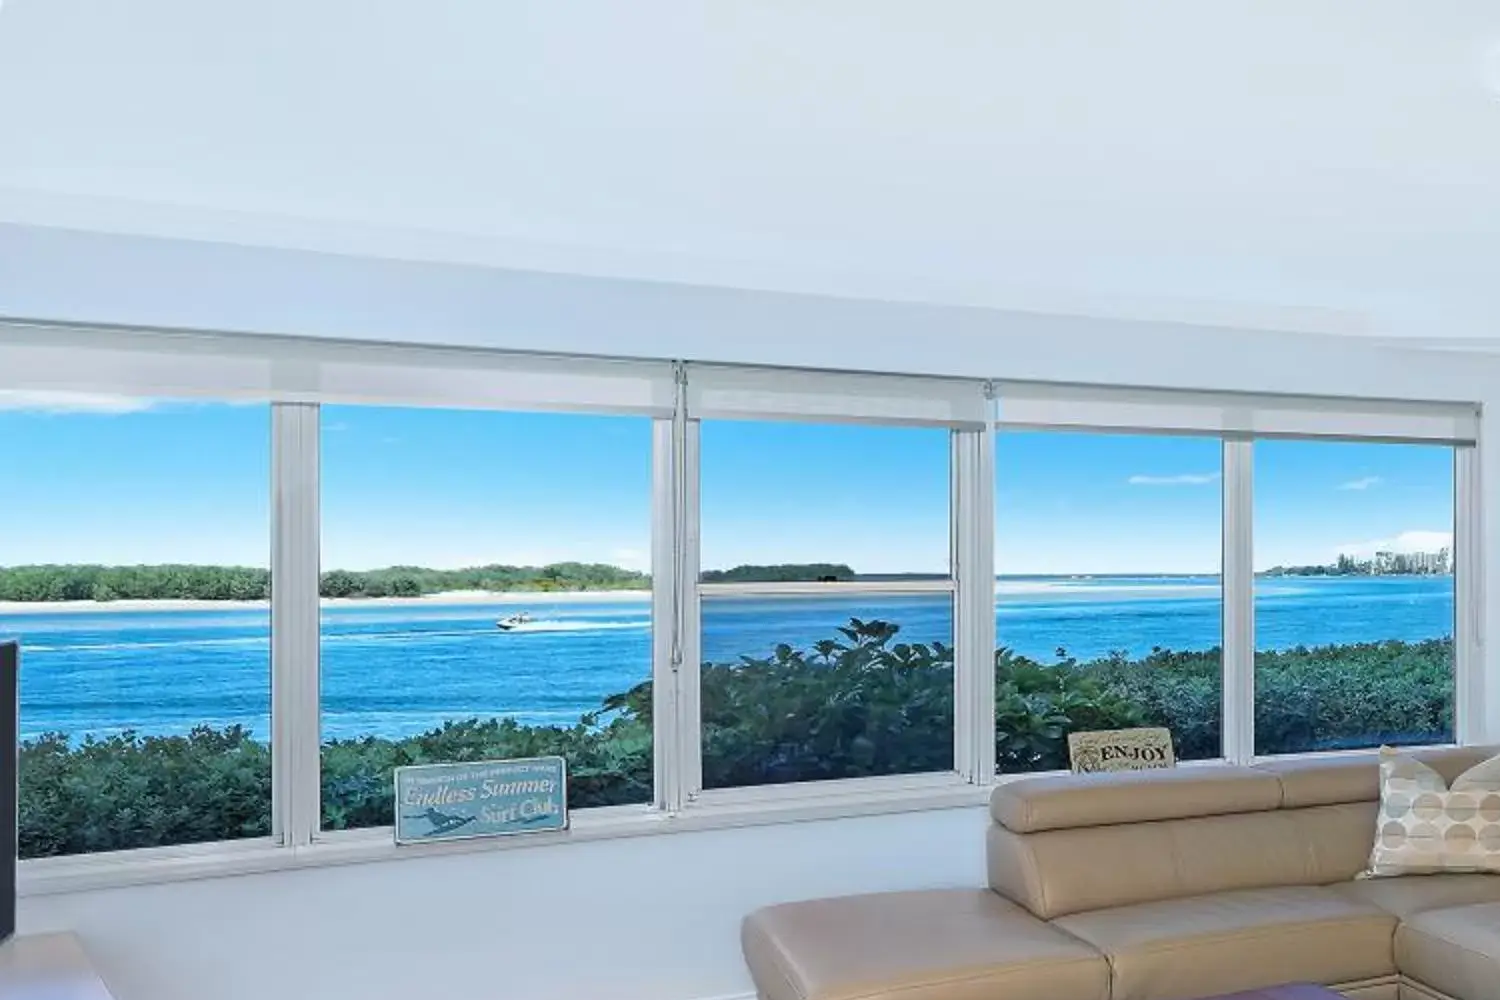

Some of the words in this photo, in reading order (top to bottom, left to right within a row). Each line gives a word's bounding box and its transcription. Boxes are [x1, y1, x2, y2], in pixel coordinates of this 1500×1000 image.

[1100, 744, 1167, 760] ENJOY
[404, 783, 477, 807] Endless
[480, 778, 555, 799] Summer
[479, 804, 517, 823] Surf
